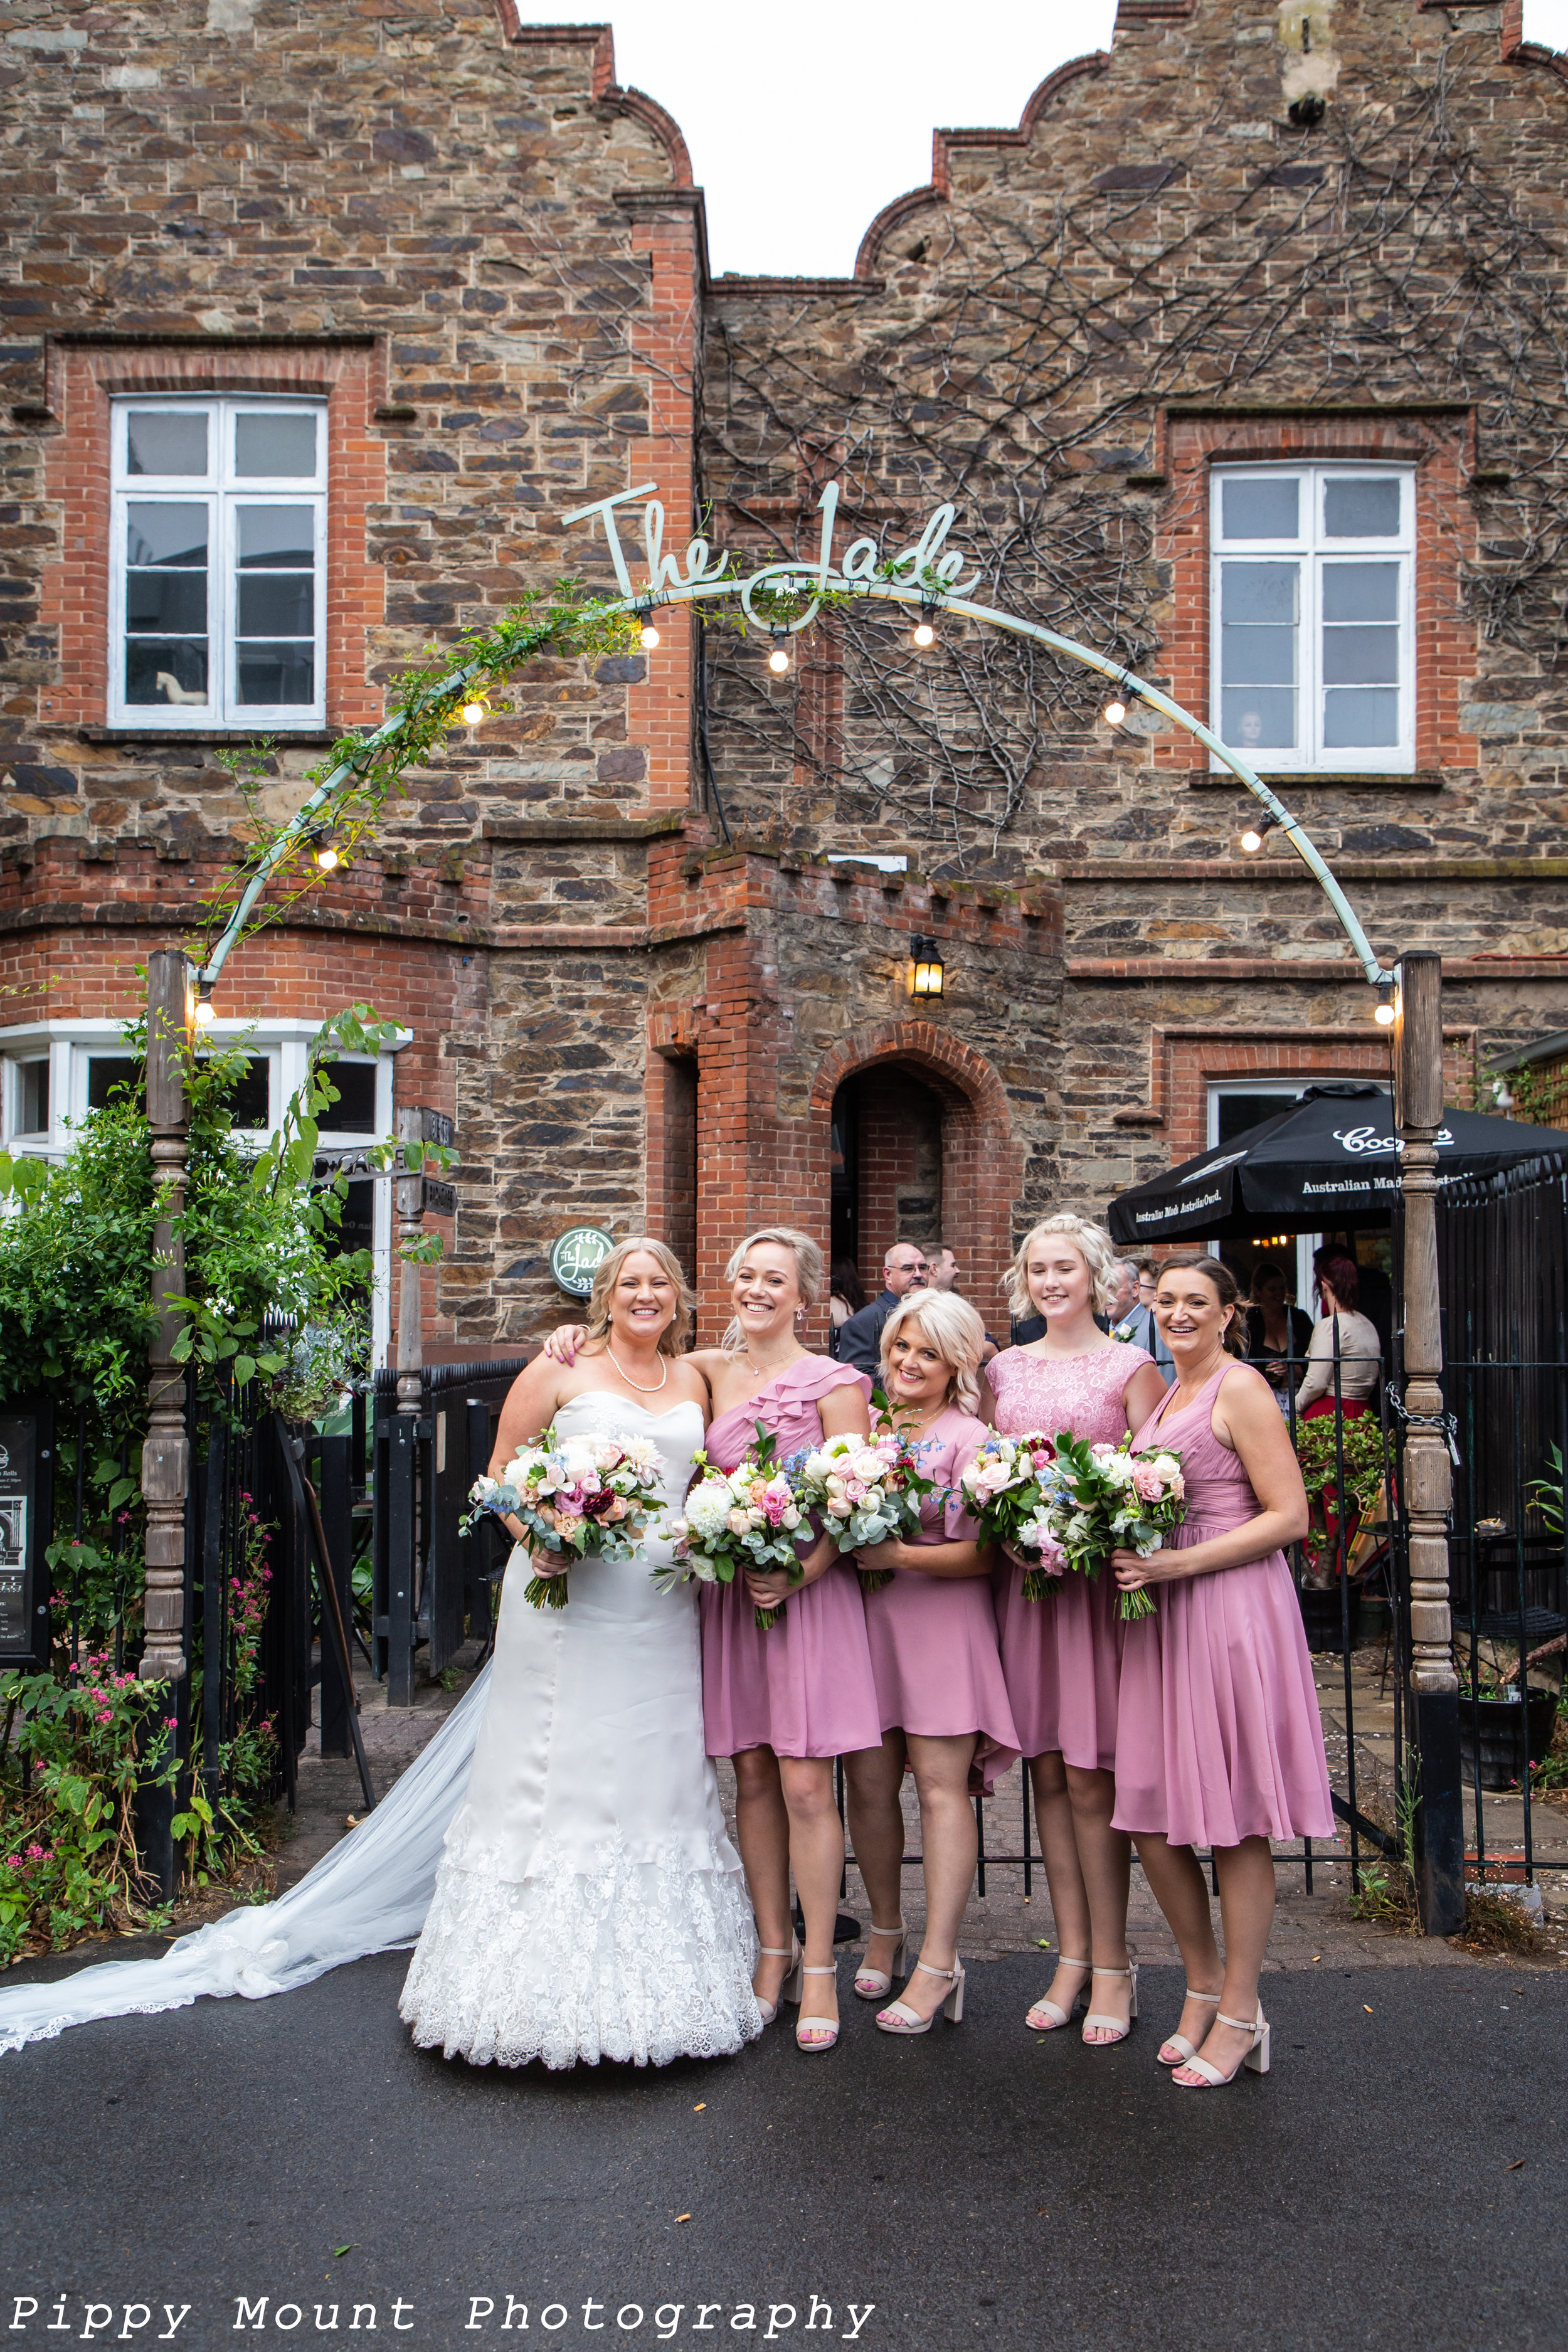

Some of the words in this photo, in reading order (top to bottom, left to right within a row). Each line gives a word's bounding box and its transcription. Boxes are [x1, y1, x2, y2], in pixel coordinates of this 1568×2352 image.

[561, 482, 729, 598] The
[741, 480, 981, 632] Jade
[1303, 1179, 1370, 1194] Australian
[1373, 1176, 1402, 1190] Mad
[1180, 1197, 1204, 1214] Austrlia
[558, 1242, 605, 1281] Jad
[559, 1250, 576, 1262] The
